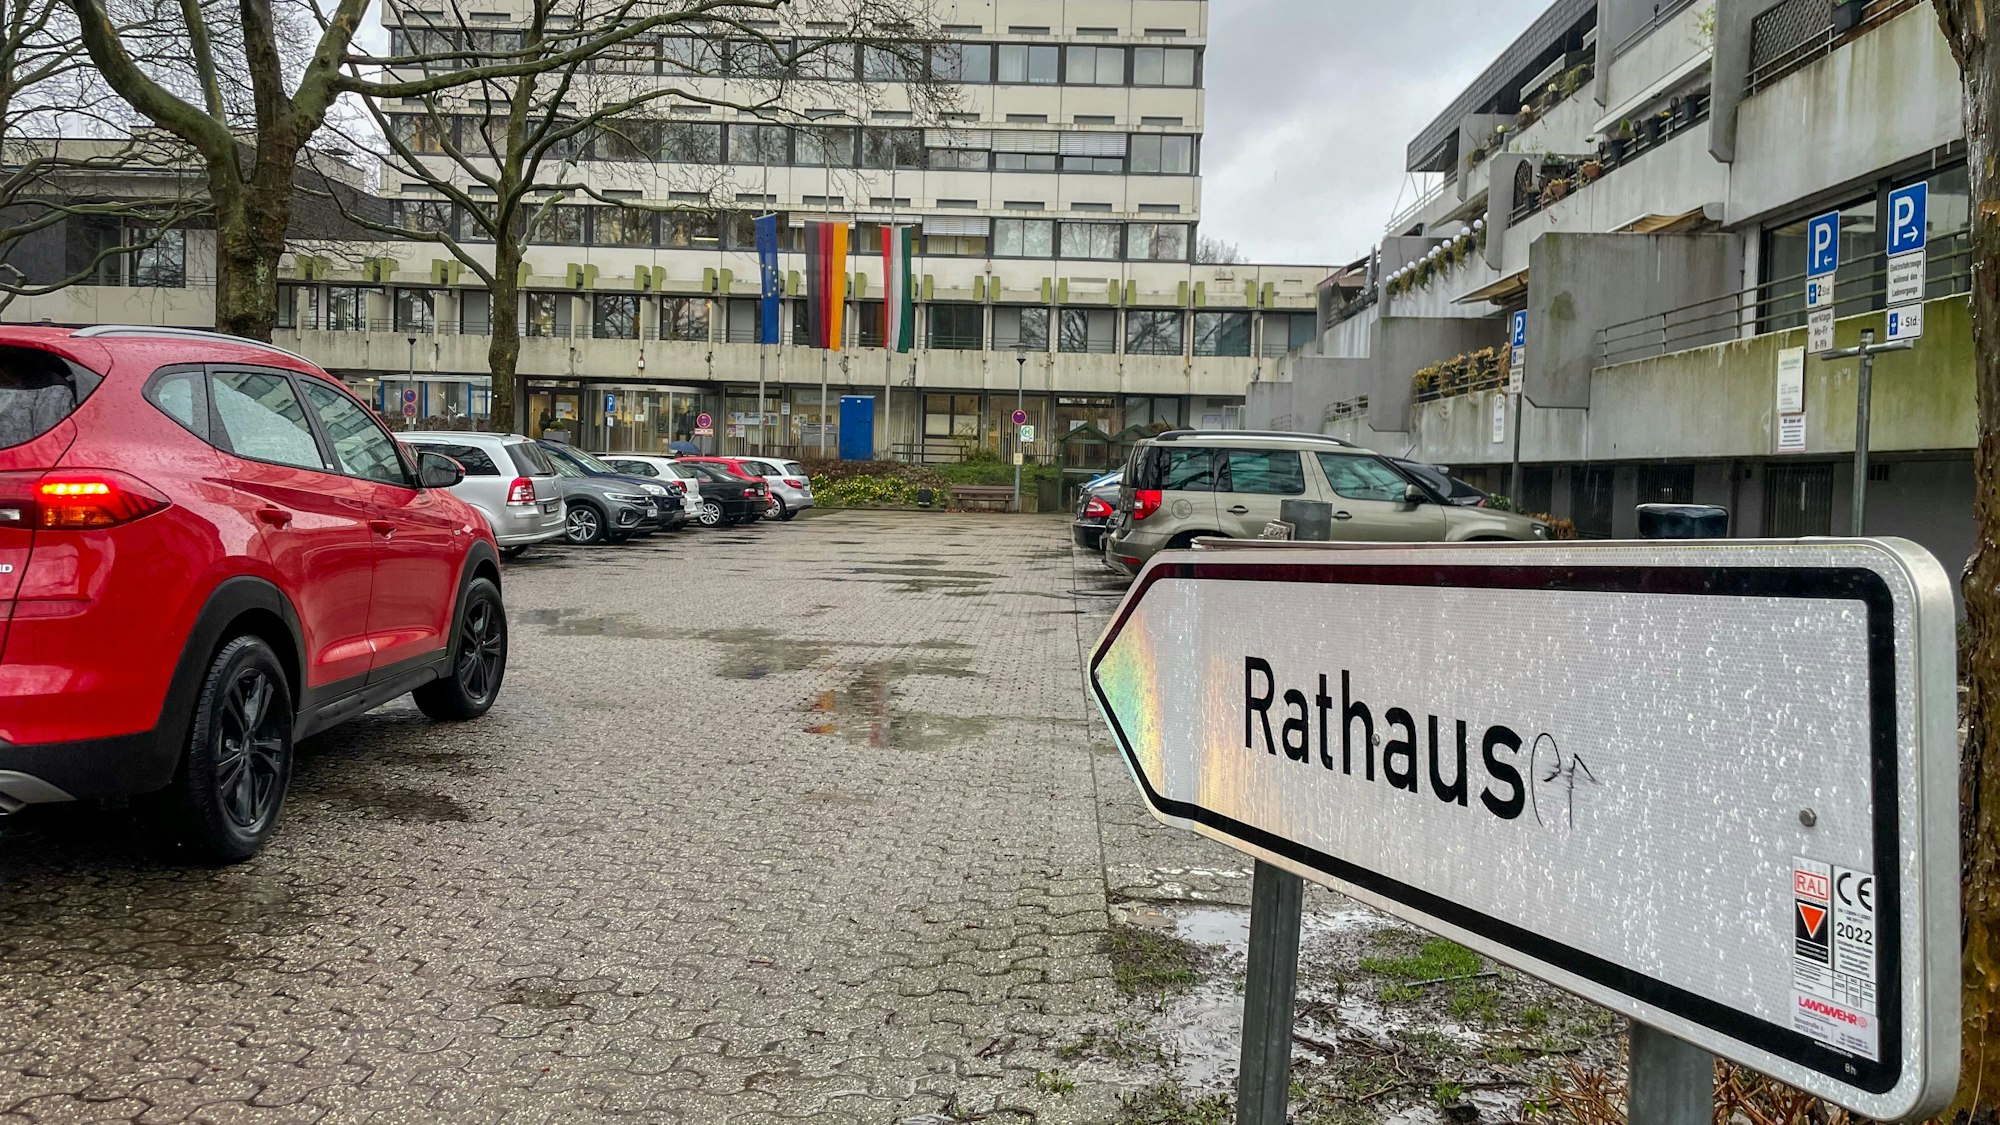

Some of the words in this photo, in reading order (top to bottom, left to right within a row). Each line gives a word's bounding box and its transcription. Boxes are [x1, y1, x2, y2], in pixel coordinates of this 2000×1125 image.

[1893, 196, 1915, 247] P
[1815, 223, 1832, 269] P
[1817, 284, 1822, 297] 2
[1514, 315, 1523, 344] P
[608, 396, 614, 410] P
[1245, 656, 1526, 820] Rathaus
[1796, 874, 1825, 896] RAL
[1836, 871, 1873, 912] CE
[1836, 922, 1873, 946] 2022
[1798, 995, 1857, 1025] LANDWEHR
